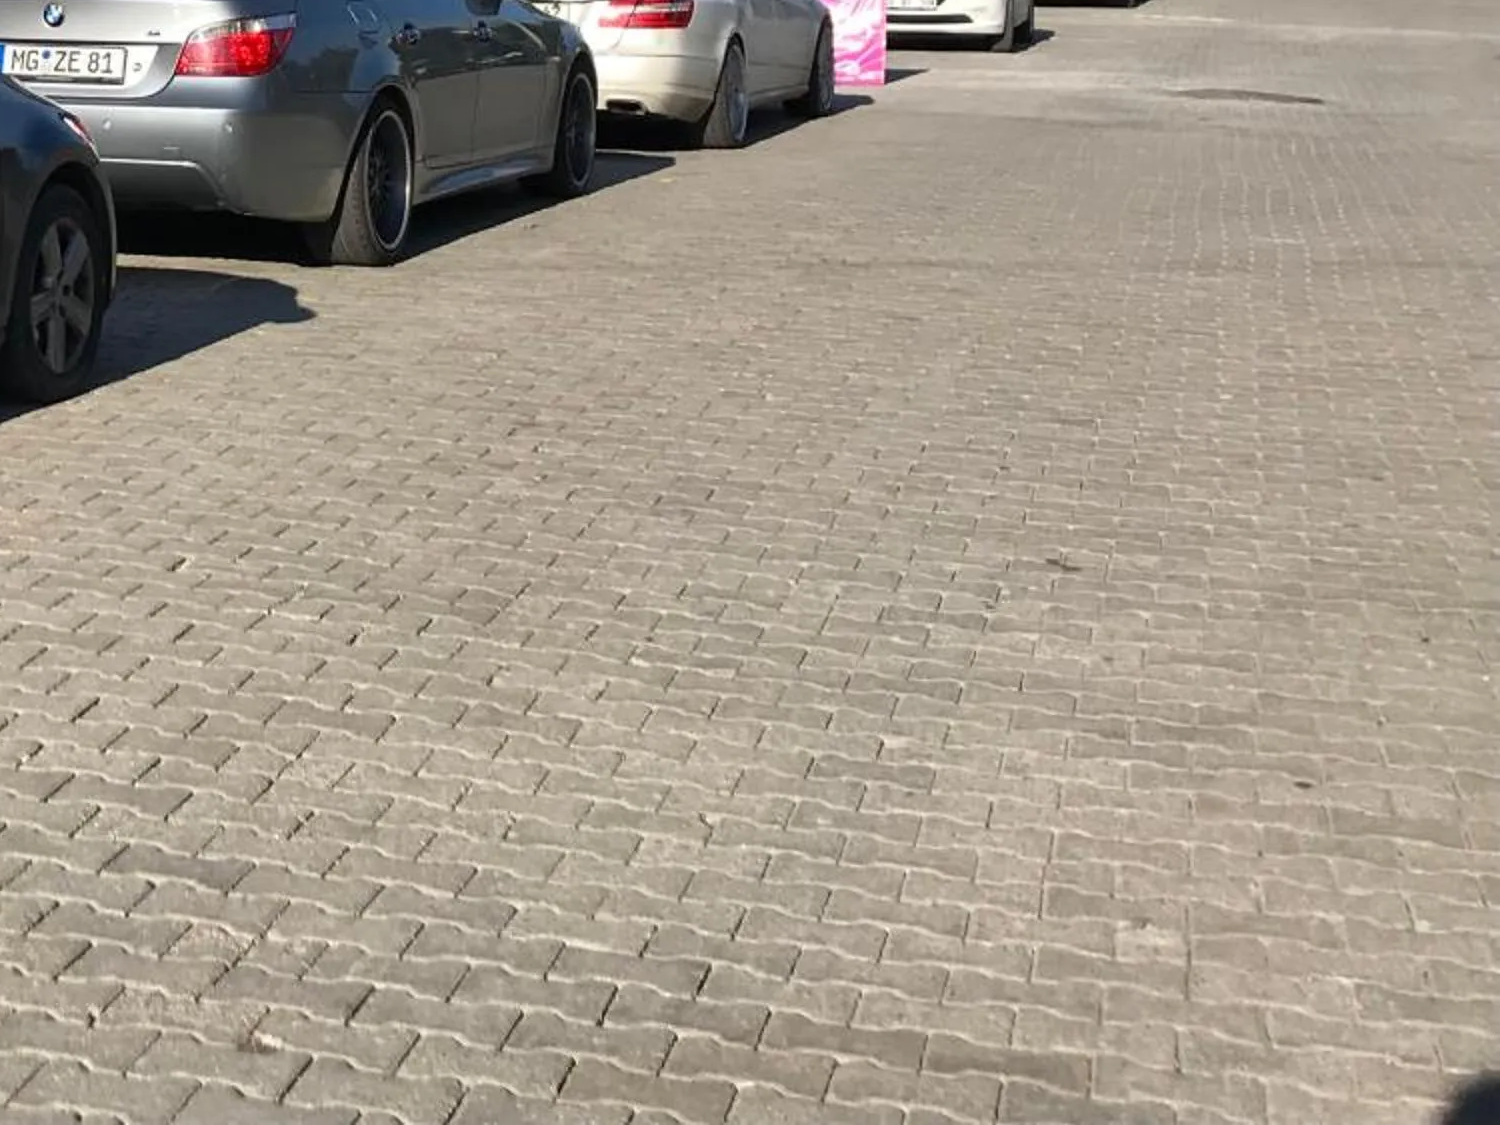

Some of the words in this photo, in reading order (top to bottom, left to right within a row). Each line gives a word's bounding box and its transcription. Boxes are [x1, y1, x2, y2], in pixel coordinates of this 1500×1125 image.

[11, 50, 39, 71] MG
[53, 51, 81, 72] ZE
[87, 52, 113, 74] 81
